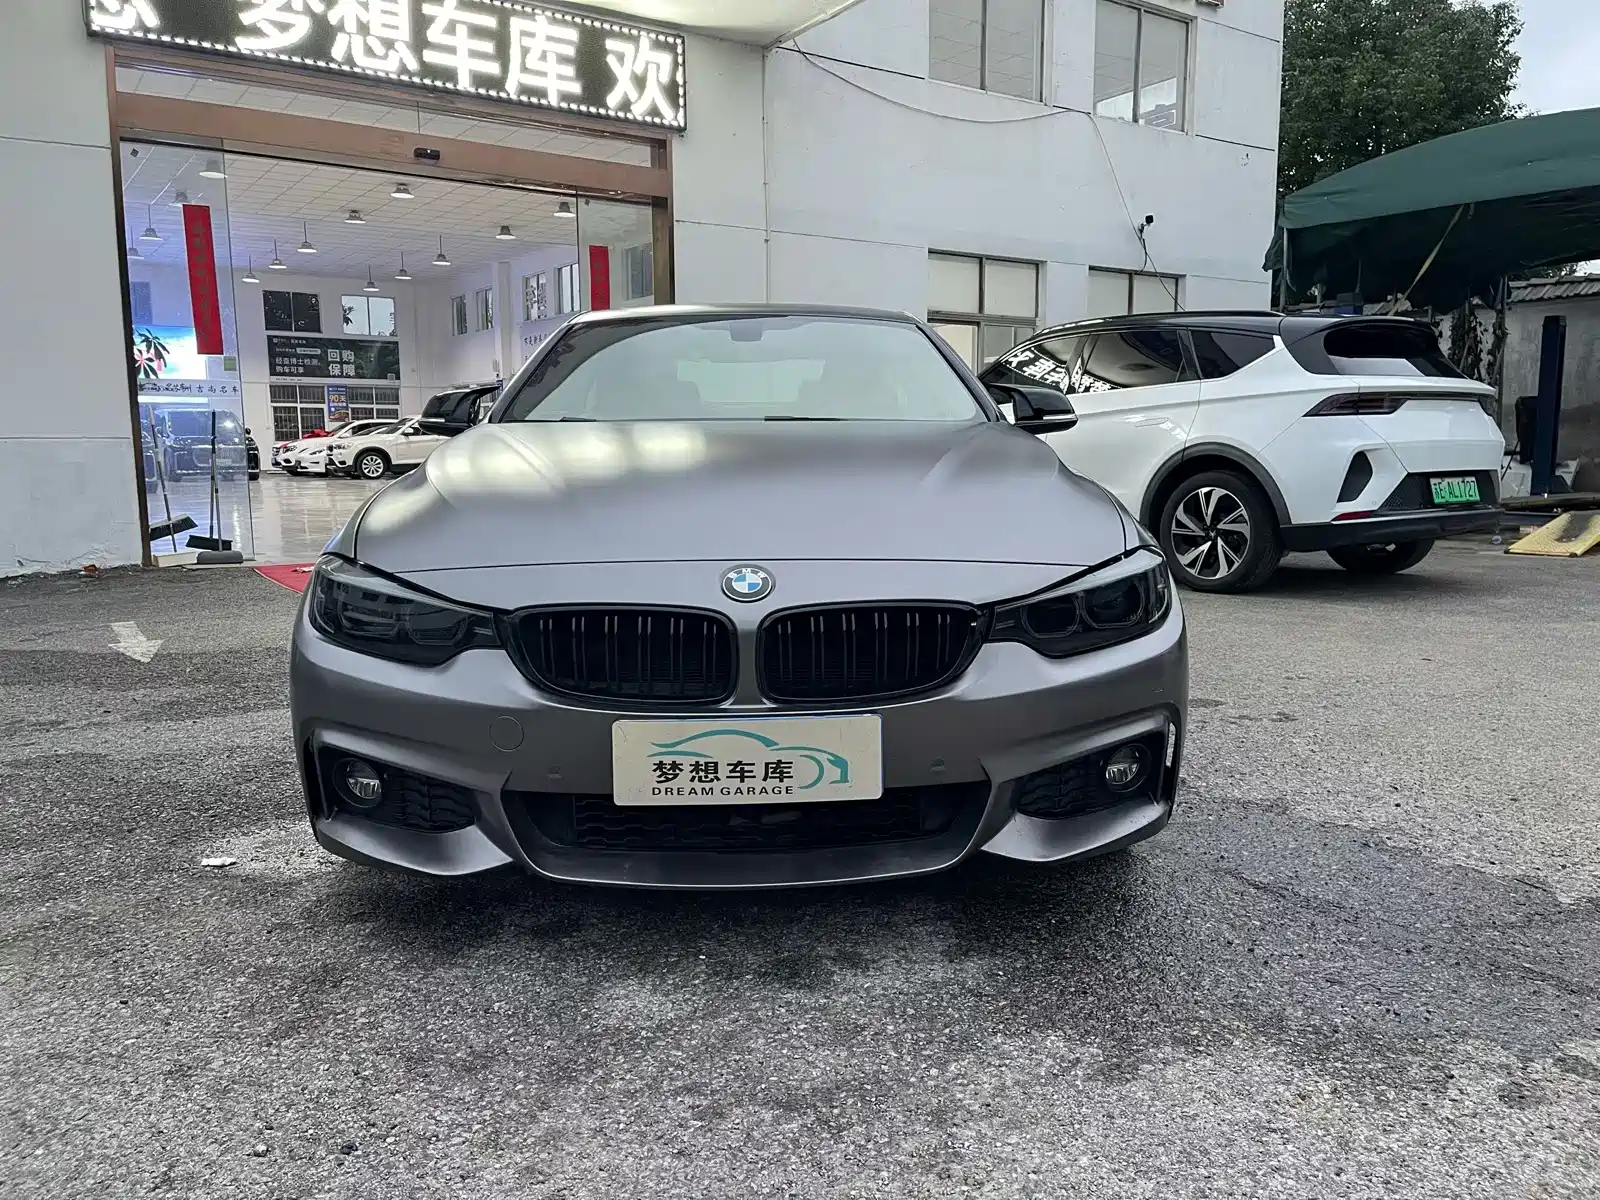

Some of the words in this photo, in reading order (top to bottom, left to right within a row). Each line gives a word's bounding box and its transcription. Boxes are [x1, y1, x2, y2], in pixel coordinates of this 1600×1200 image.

[235, 0, 582, 102] 梦想车库
[605, 35, 675, 120] 欢
[327, 349, 355, 363] 回购
[328, 363, 356, 376] 保障
[329, 394, 347, 403] 90天
[727, 568, 768, 579] BMW
[652, 760, 794, 783] 梦想车库
[652, 786, 714, 796] DREAM
[721, 785, 794, 796] GARAGE
